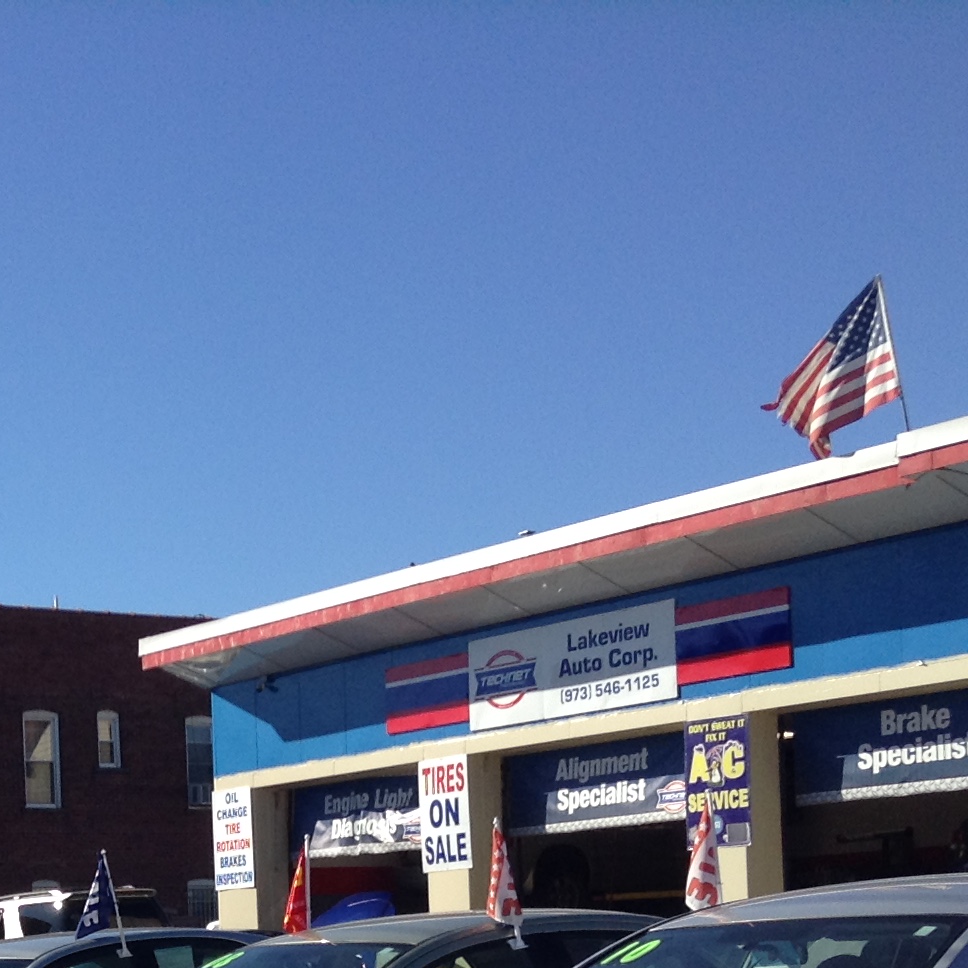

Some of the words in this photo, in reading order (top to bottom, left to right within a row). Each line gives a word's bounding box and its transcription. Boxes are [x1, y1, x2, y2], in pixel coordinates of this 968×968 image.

[567, 623, 650, 652] Lakeview
[559, 657, 602, 678] Auto
[609, 646, 658, 667] Corp.
[560, 684, 592, 704] (973)
[595, 674, 660, 697] 546-1125
[737, 719, 745, 728] IT
[880, 704, 951, 736] Brake
[705, 733, 717, 742] FIX
[718, 732, 726, 741] IT
[555, 747, 649, 783] Alignment
[857, 731, 968, 774] Specialis
[422, 762, 465, 796] TIRES
[225, 792, 239, 804] OIL
[324, 791, 370, 817] Engine
[374, 787, 414, 811] Light
[557, 778, 646, 814] Specialist
[688, 787, 750, 813] SEVICE
[216, 806, 247, 820] CHANGE
[429, 797, 460, 828] ON
[225, 822, 241, 835] TIRE
[216, 838, 251, 853] ROTATION
[425, 832, 468, 865] SALE
[220, 854, 247, 868] BRAKES
[216, 871, 253, 885] INSPECTION
